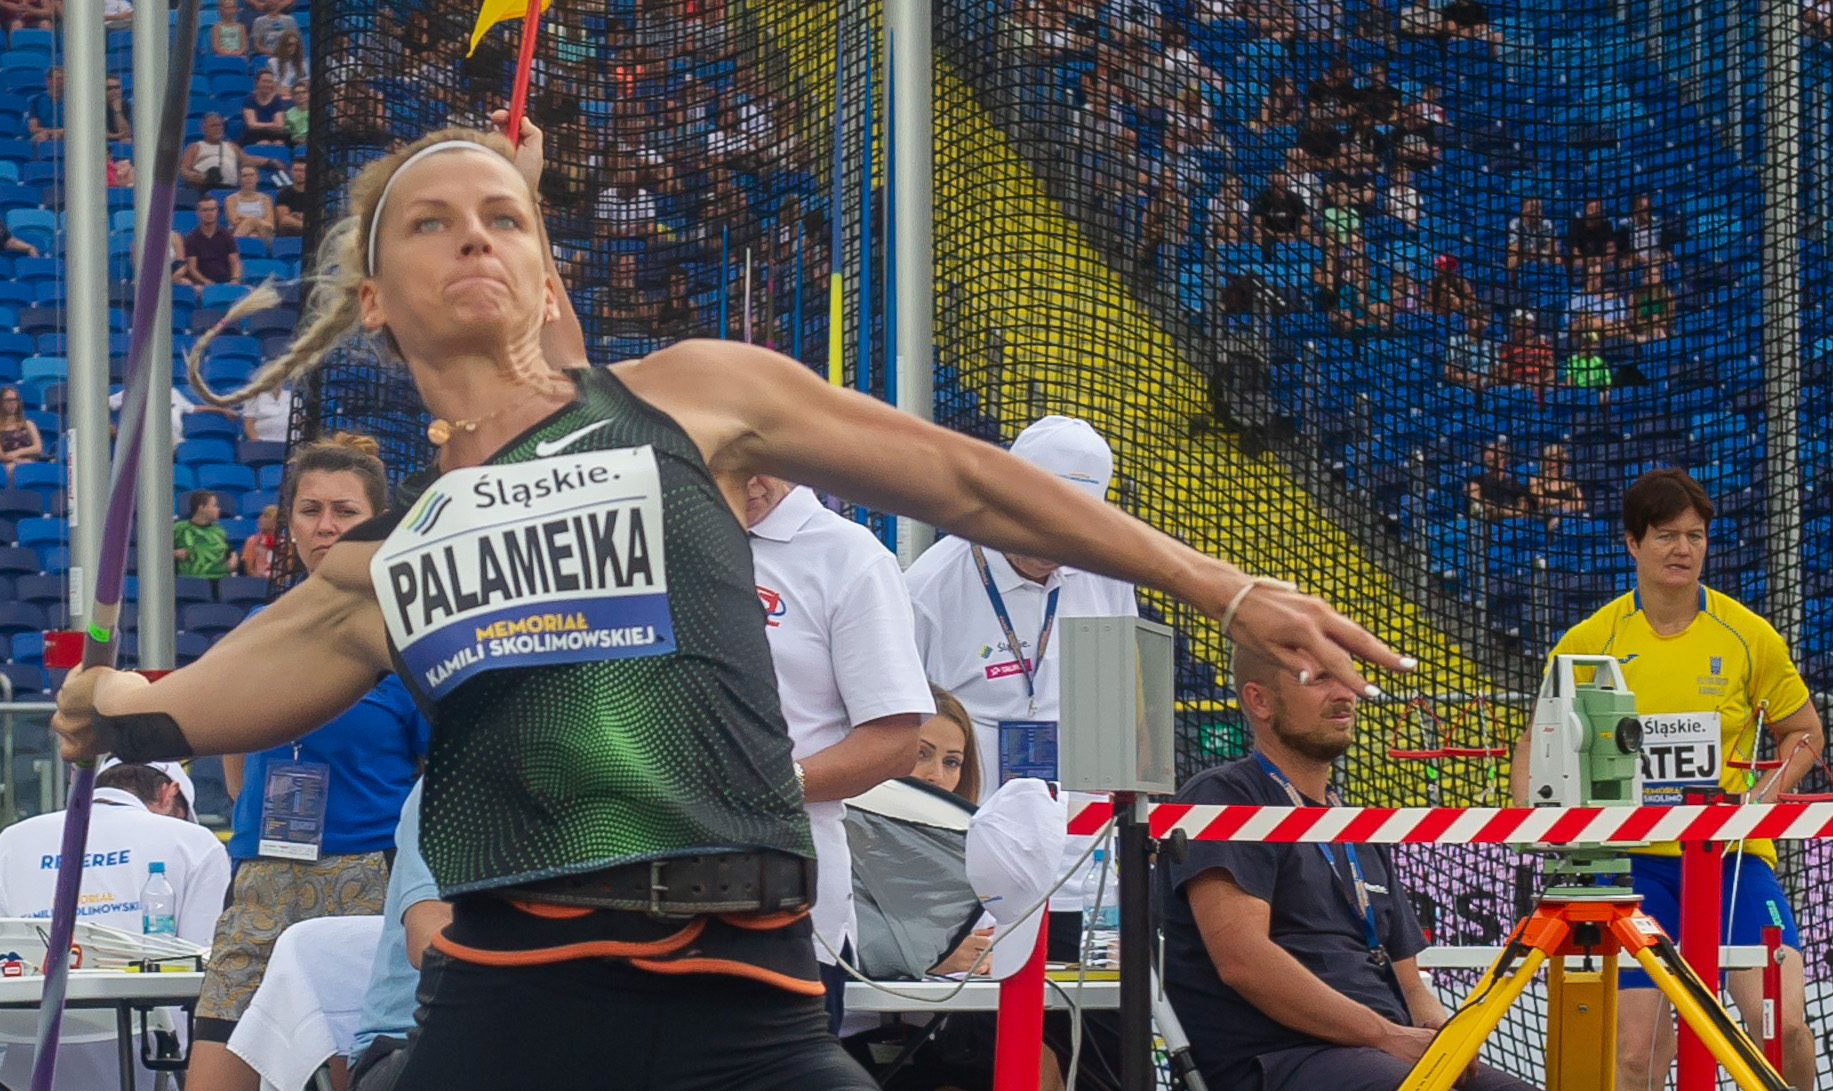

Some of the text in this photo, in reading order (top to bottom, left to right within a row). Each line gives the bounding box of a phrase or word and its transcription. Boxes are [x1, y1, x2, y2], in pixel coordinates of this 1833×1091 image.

[472, 464, 621, 508] Śląskie.
[387, 507, 654, 637] PALAMEIKA
[475, 612, 588, 641] MEMORIAŁ
[425, 626, 655, 688] KAMILI SKOLIMOWSKIEJ
[1644, 717, 1707, 738] Śląskie.
[1640, 744, 1716, 780] ATEJ
[40, 849, 131, 870] REEREE
